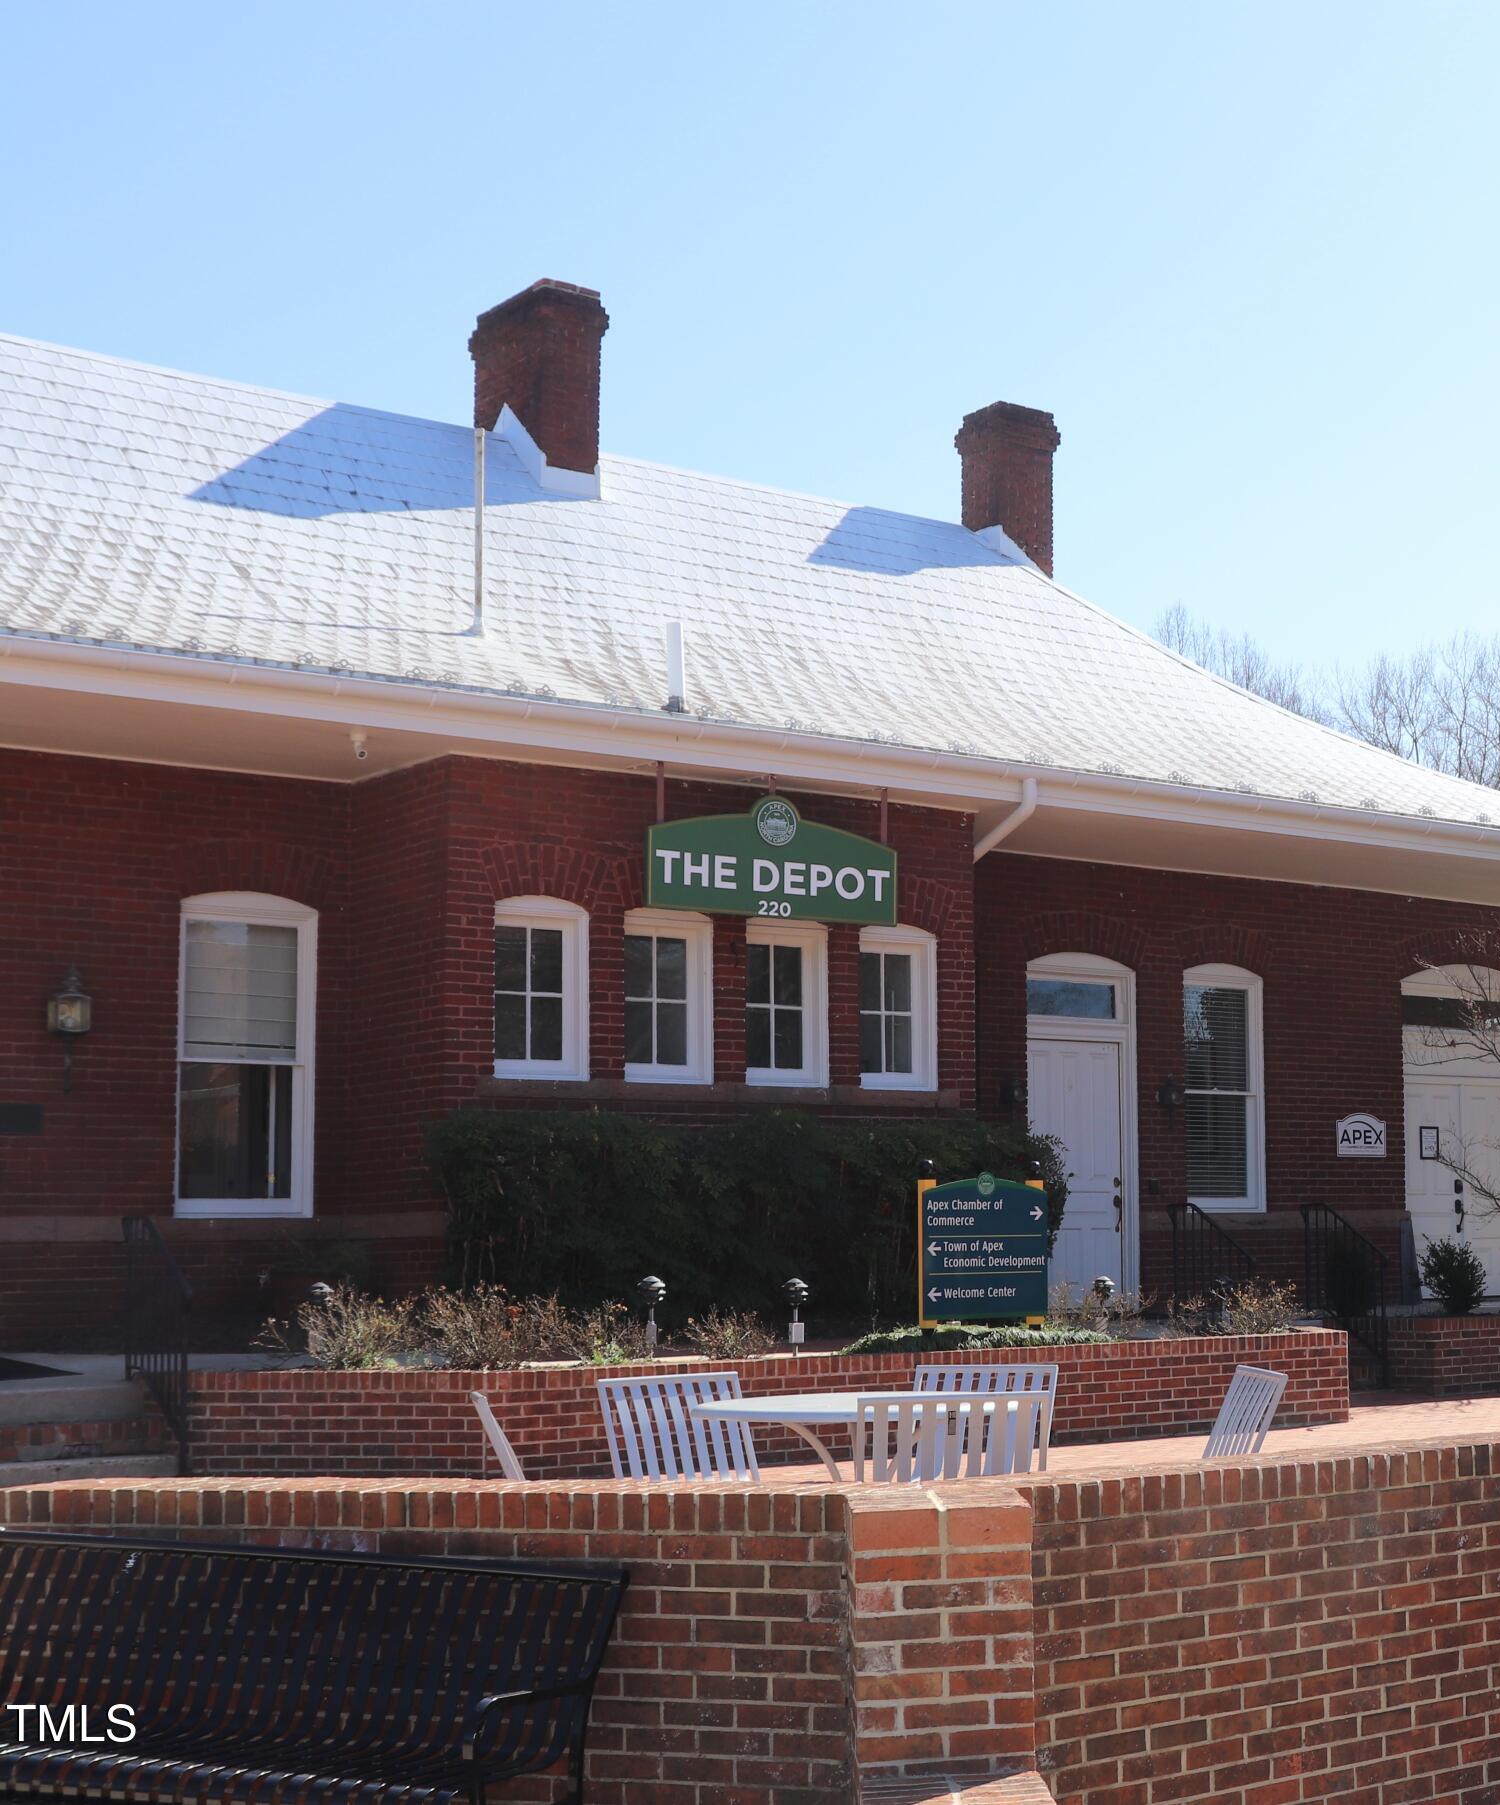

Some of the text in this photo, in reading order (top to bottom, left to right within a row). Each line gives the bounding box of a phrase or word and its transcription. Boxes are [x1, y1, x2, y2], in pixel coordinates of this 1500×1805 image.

[769, 803, 786, 812] APEX
[655, 849, 891, 902] THE DEPOT
[758, 900, 792, 918] 220
[1340, 1129, 1384, 1145] APEX
[927, 1199, 1004, 1213] Apex Chamber of
[927, 1215, 975, 1226] Commerce
[943, 1240, 1004, 1253] Town of Apex
[943, 1255, 1046, 1269] Economic Development
[943, 1286, 1017, 1299] Welcome Center
